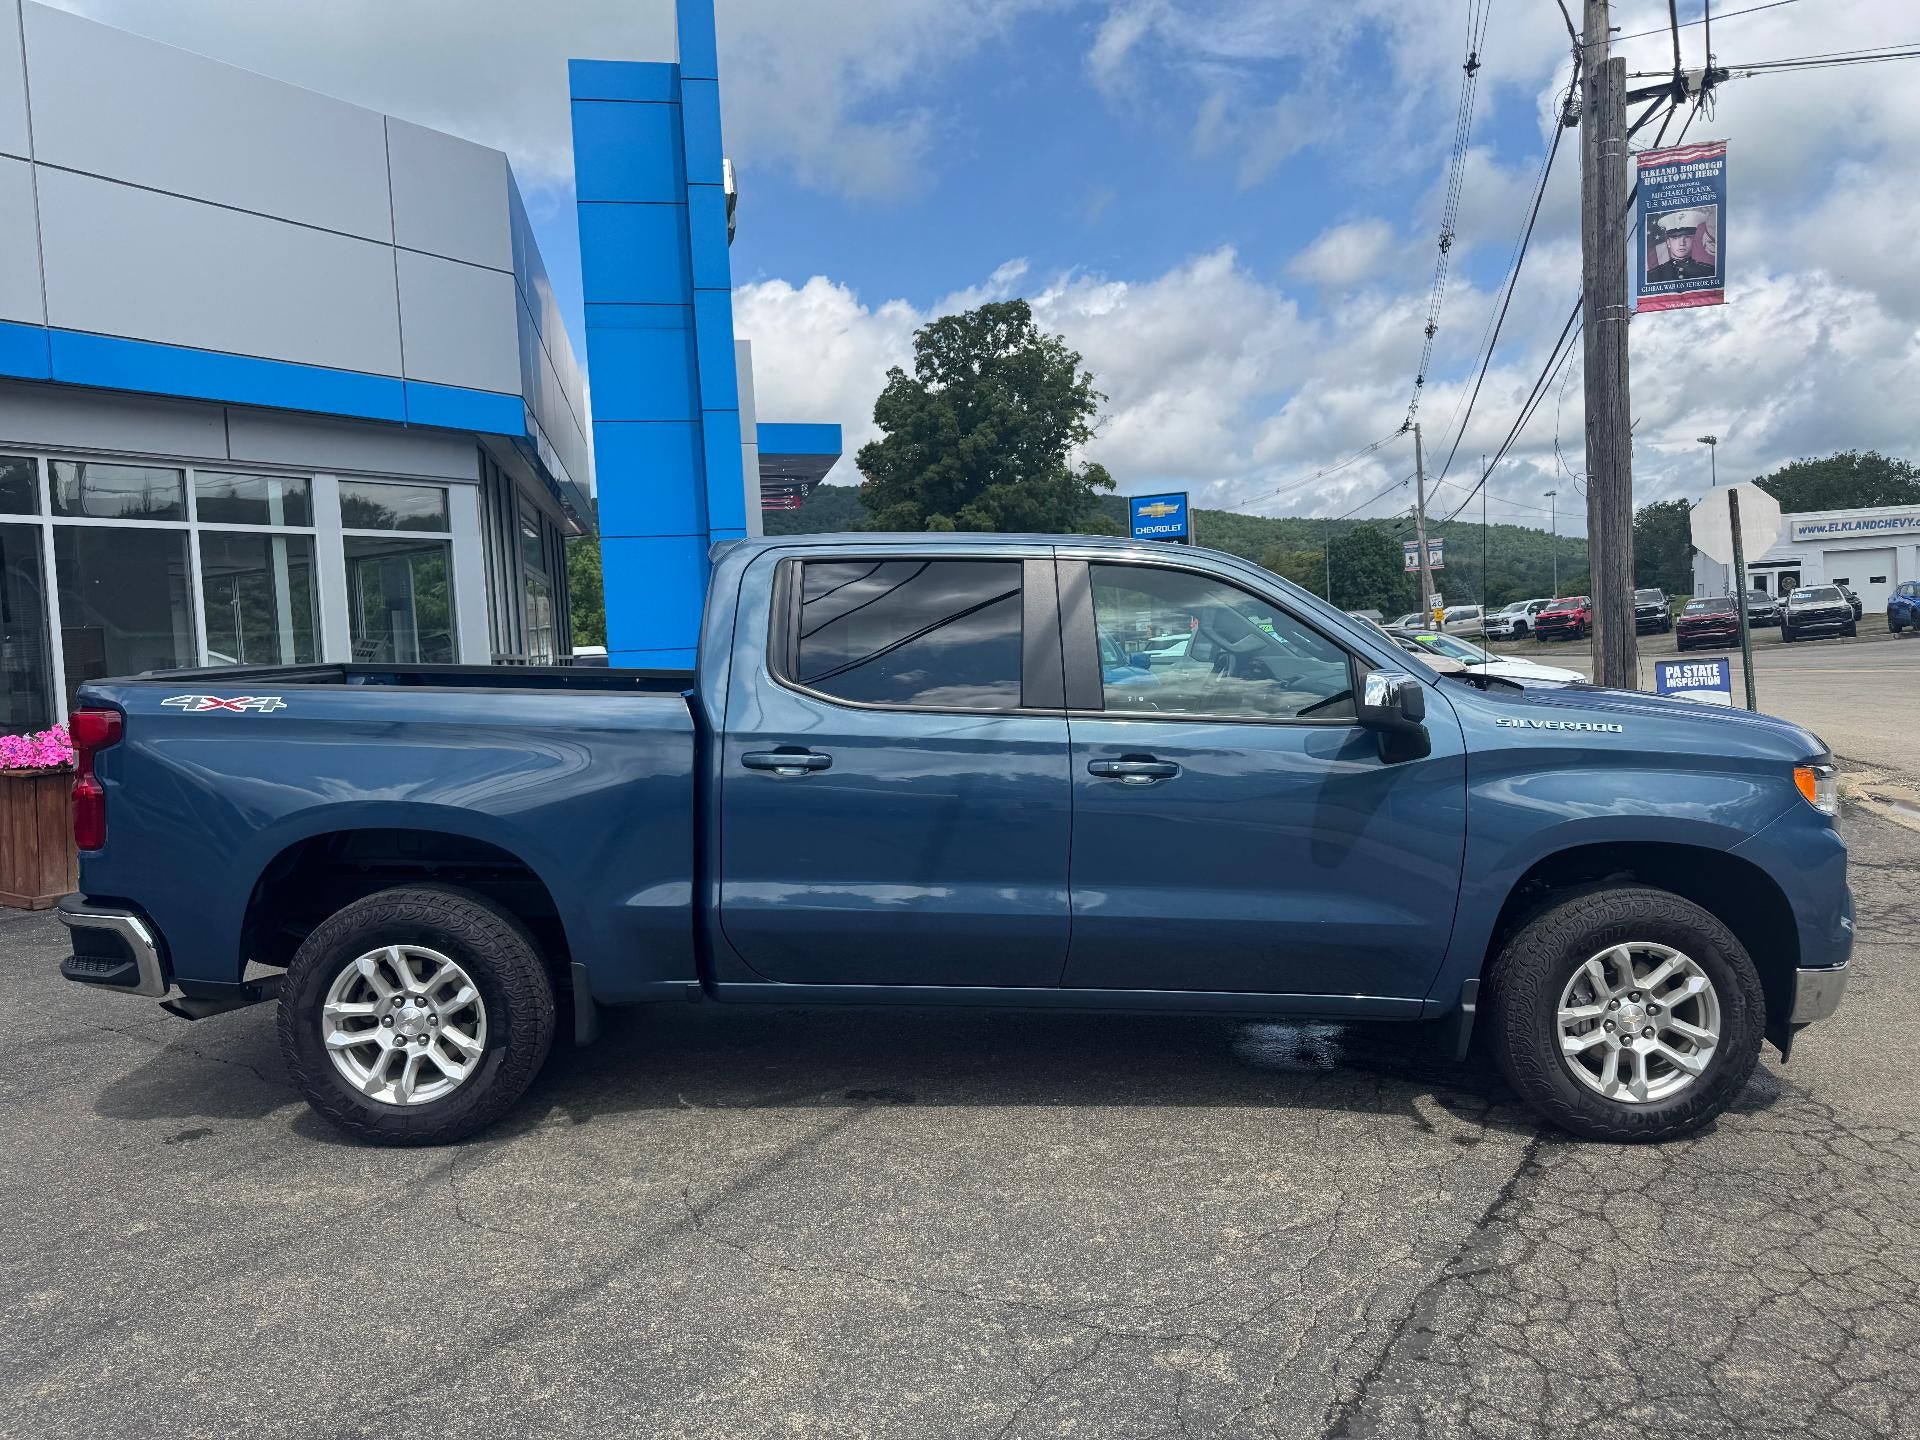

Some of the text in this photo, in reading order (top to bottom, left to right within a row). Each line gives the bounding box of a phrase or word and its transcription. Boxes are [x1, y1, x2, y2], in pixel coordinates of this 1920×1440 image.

[1640, 161, 1723, 179] ELKLAND BOROUGH
[1644, 169, 1719, 186] HOMETOWN HERO
[1651, 185, 1712, 199] MICHAEL PLANK
[1661, 196, 1691, 207] MARINE
[1691, 193, 1717, 203] CORPS
[1135, 523, 1182, 535] CHEVROLET
[1665, 663, 1720, 679] PA STATE
[1666, 675, 1721, 688] INSPECTION
[1496, 718, 1623, 733] SILVERADO
